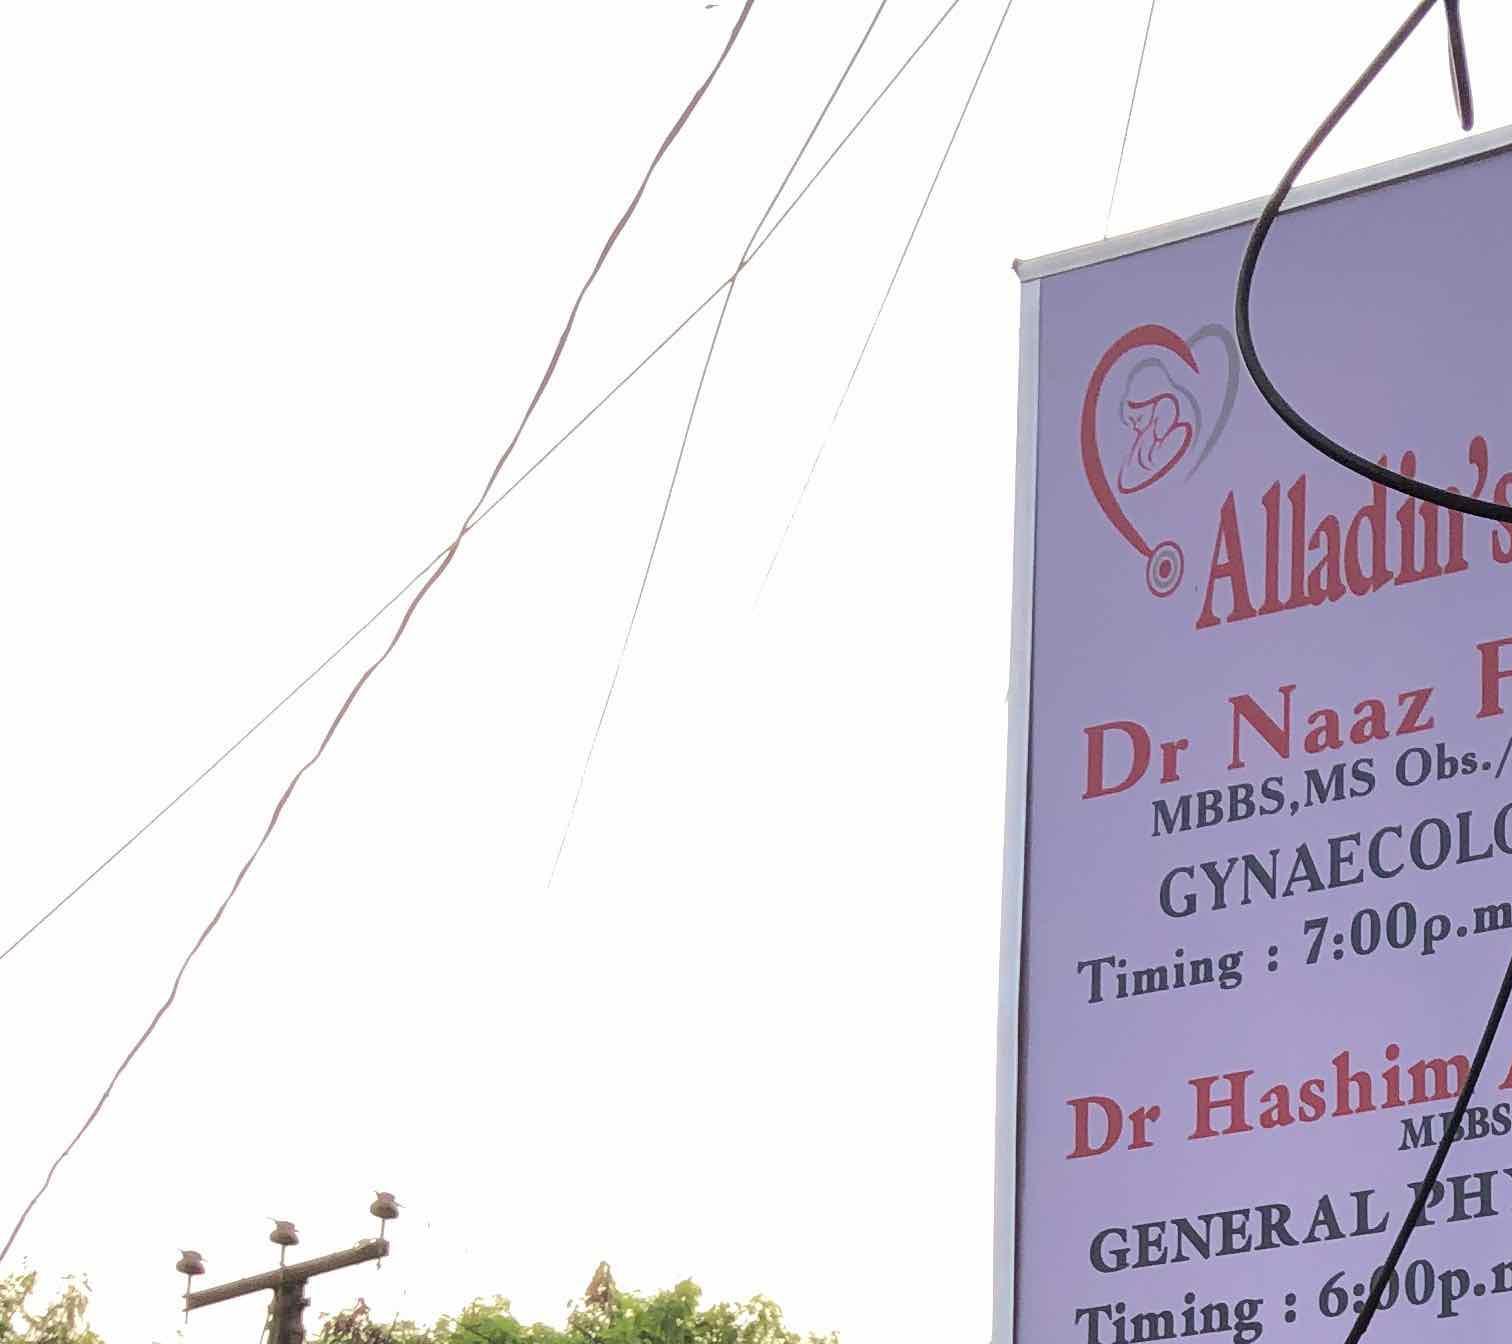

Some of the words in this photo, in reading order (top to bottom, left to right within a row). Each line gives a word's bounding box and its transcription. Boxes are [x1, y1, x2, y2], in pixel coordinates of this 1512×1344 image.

[1081, 720, 1189, 801] Dr
[1226, 682, 1435, 771] Naaz
[1150, 759, 1376, 838] MBBS,MS
[1077, 942, 1243, 1006] Timing
[1065, 1093, 1159, 1161] Dr
[1186, 1042, 1474, 1144] Hashim
[1088, 1188, 1391, 1275] GENERAL
